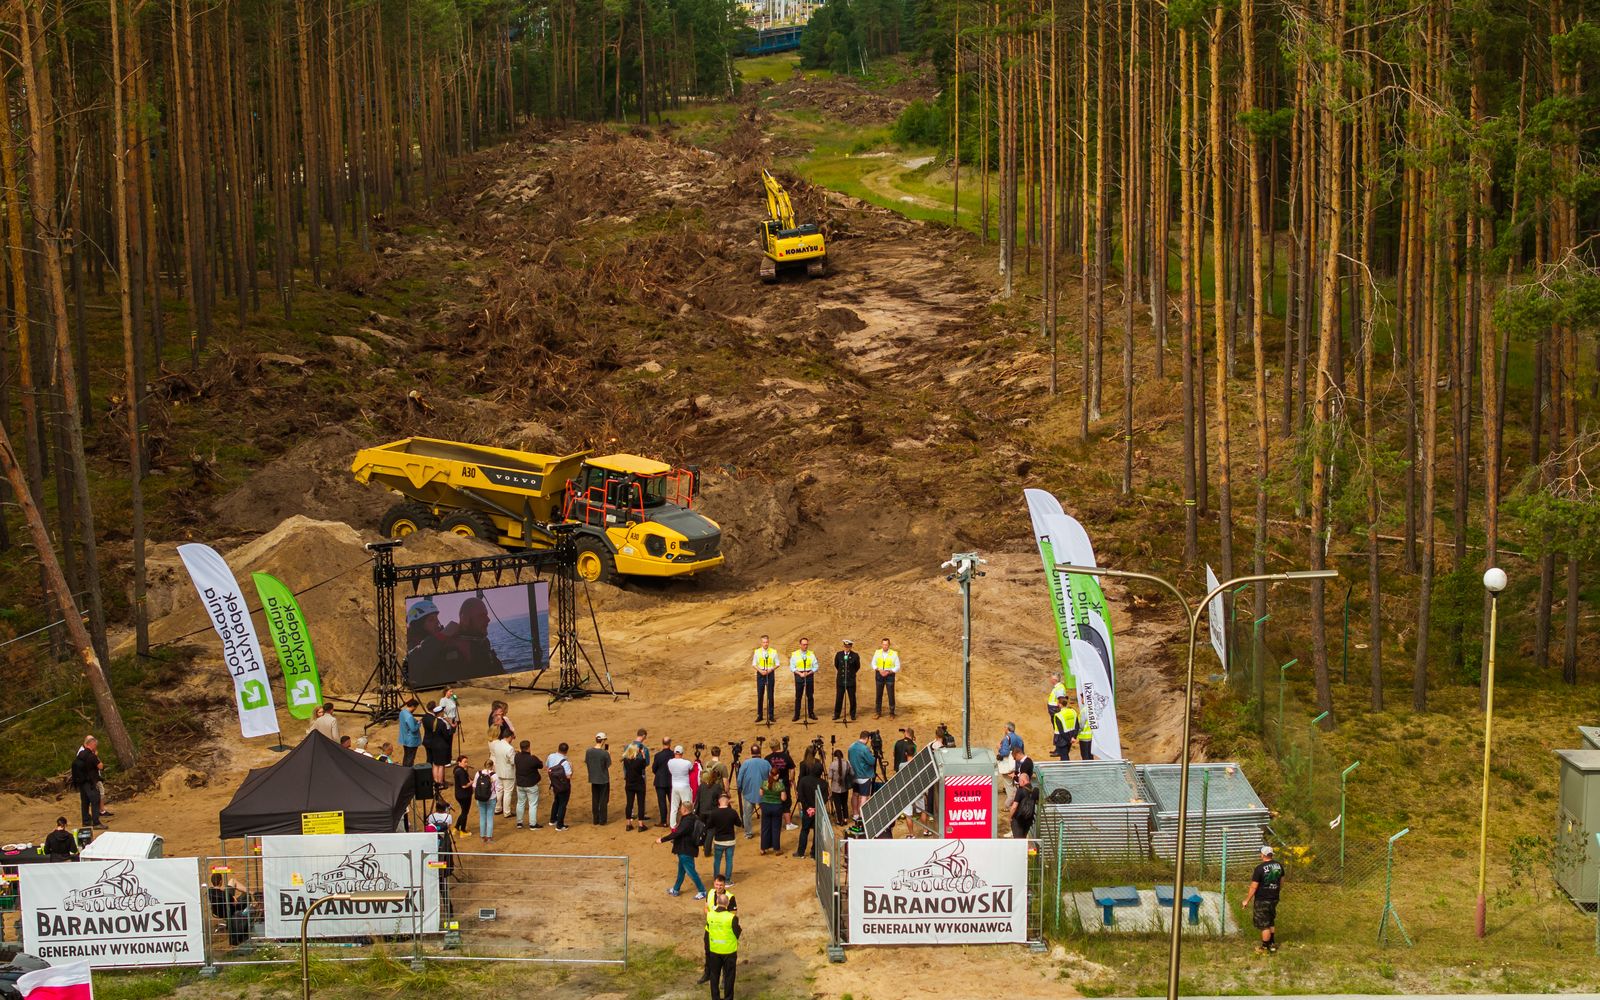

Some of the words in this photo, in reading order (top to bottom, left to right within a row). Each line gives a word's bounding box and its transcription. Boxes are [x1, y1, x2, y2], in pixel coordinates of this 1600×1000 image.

[785, 245, 819, 255] KOMATSU
[462, 466, 476, 478] A30
[496, 474, 536, 485] VOLVO
[670, 541, 677, 550] 6
[948, 809, 987, 821] WOW
[323, 871, 344, 881] UTB
[909, 868, 930, 878] UTB
[81, 888, 101, 898] UTB
[863, 888, 1013, 914] BARANOWSKI
[37, 905, 187, 937] BARANOWSKI
[862, 923, 931, 935] GENERALNY
[934, 921, 1013, 934] WYKONAWCA
[38, 944, 107, 958] GENERALNY
[110, 941, 190, 955] WYKONAWCA
